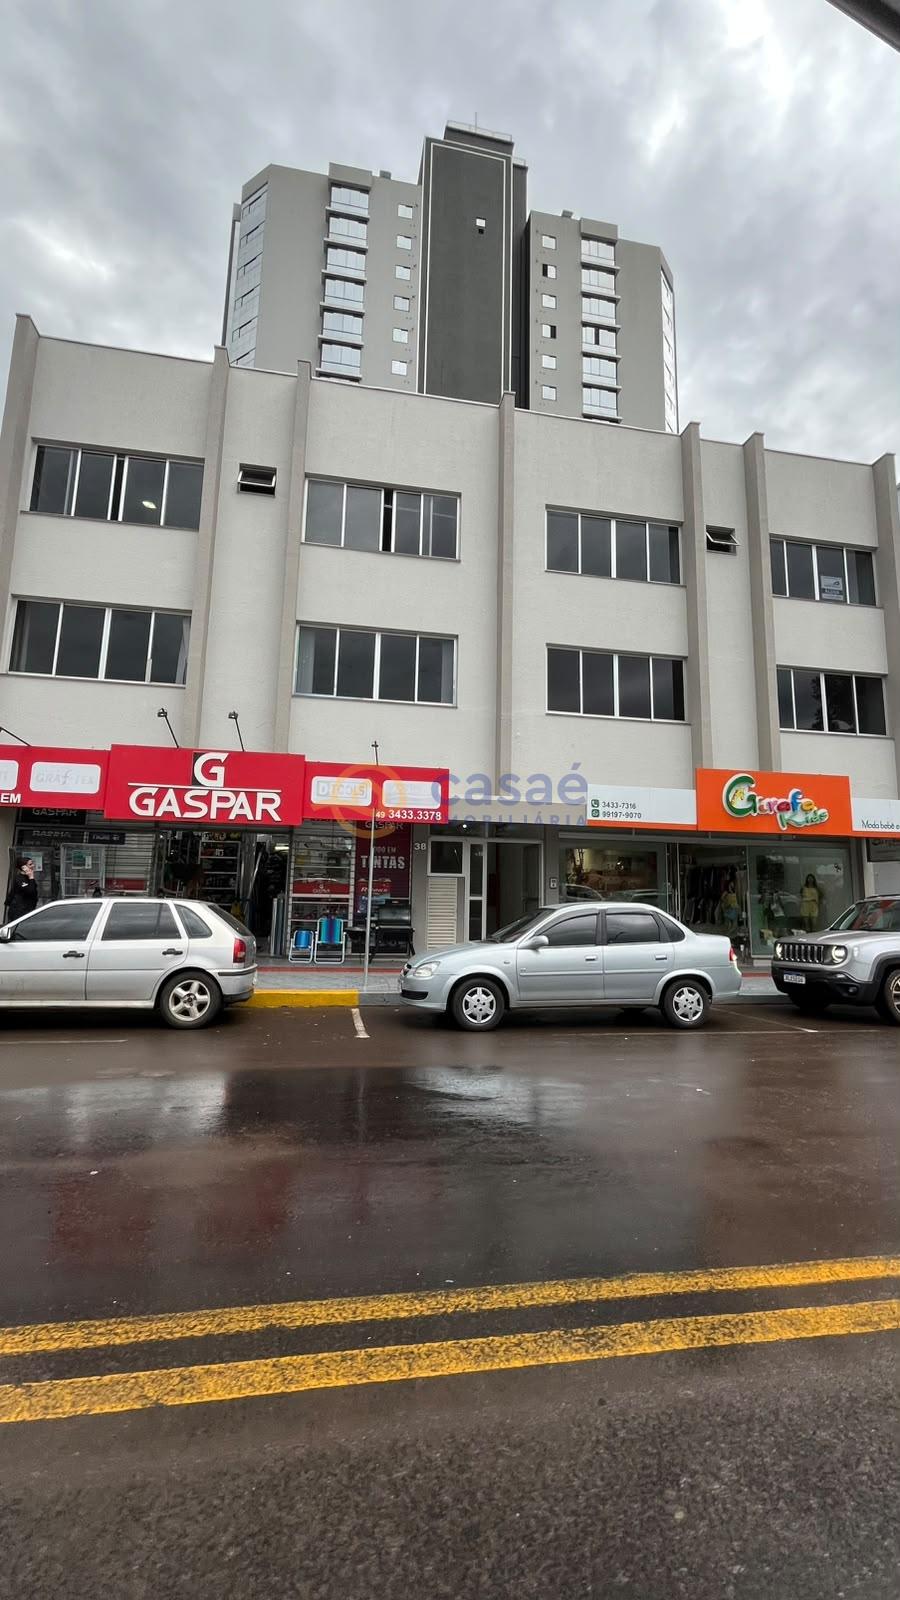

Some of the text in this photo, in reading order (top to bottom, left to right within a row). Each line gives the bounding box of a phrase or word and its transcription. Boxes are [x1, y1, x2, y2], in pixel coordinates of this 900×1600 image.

[194, 752, 229, 788] G
[129, 787, 282, 821] GASPAR
[375, 810, 442, 821] 49 3433.3378
[602, 811, 642, 819] 99197-9070
[862, 820, 880, 829] Moda
[360, 855, 405, 869] TNTAS
